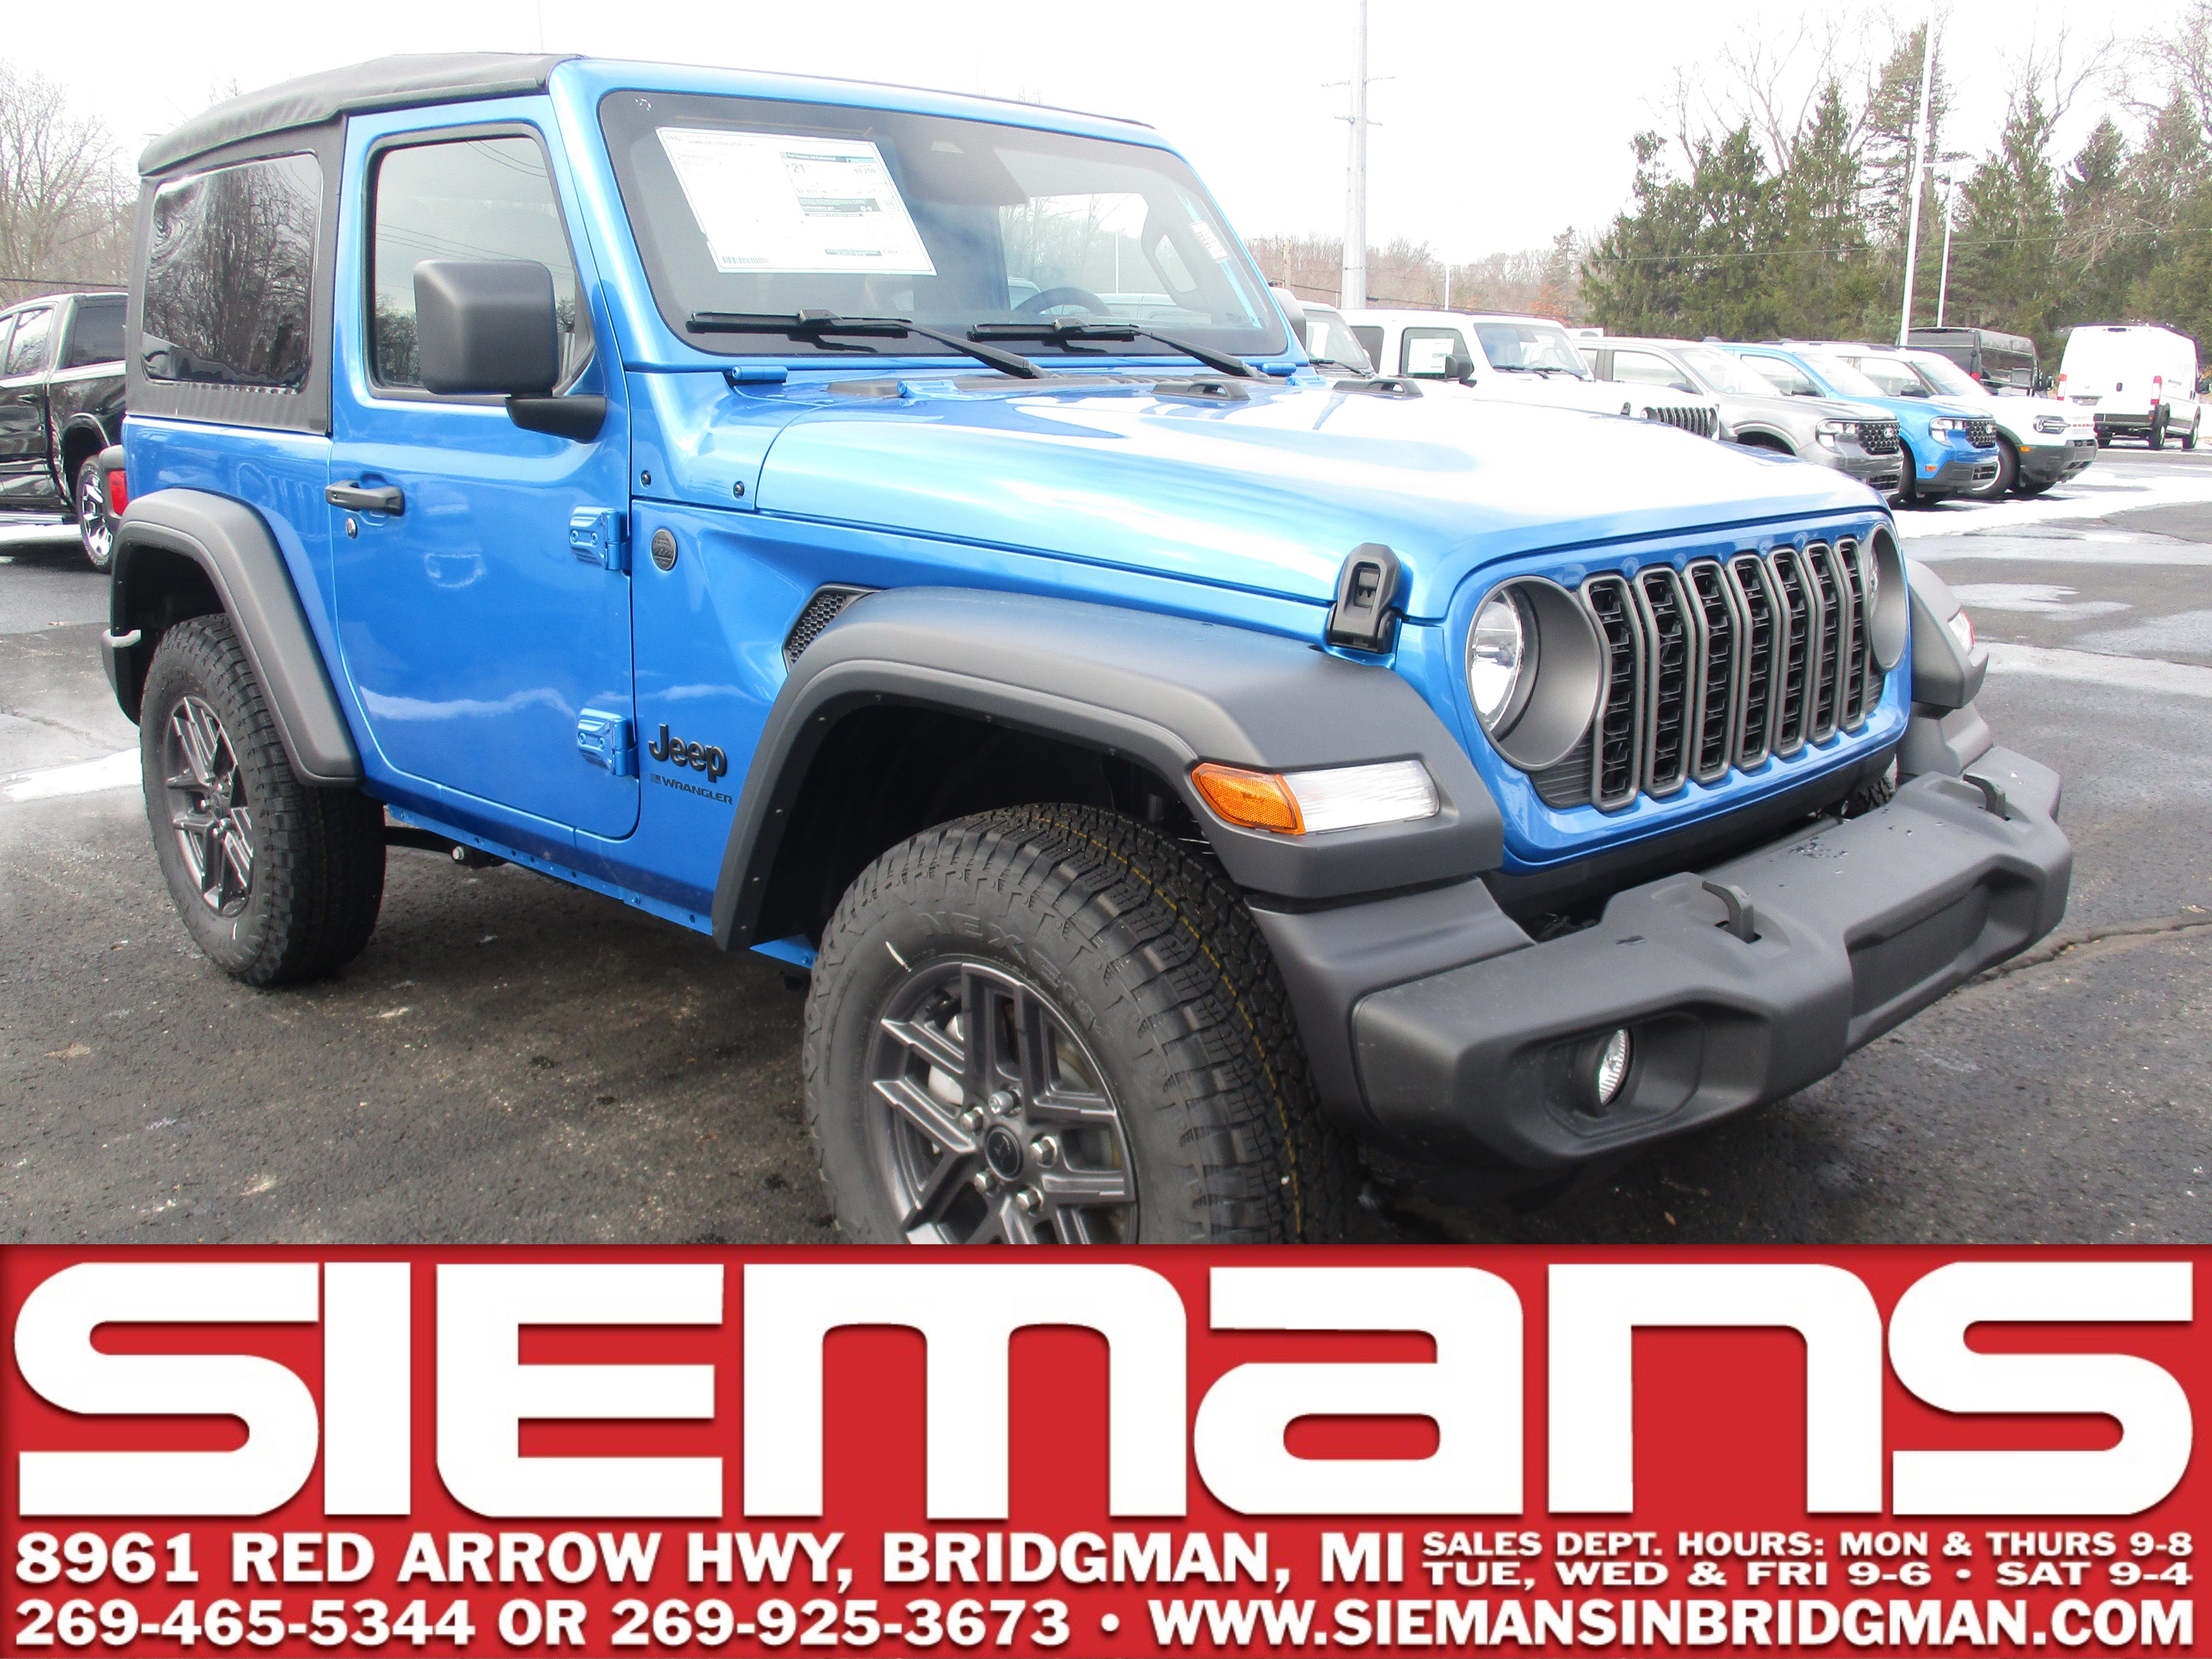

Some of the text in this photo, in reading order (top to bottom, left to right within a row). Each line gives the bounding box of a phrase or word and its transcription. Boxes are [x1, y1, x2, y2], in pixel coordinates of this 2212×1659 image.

[791, 163, 805, 174] 21
[648, 723, 728, 784] Jeep
[660, 775, 734, 805] WRANGLER
